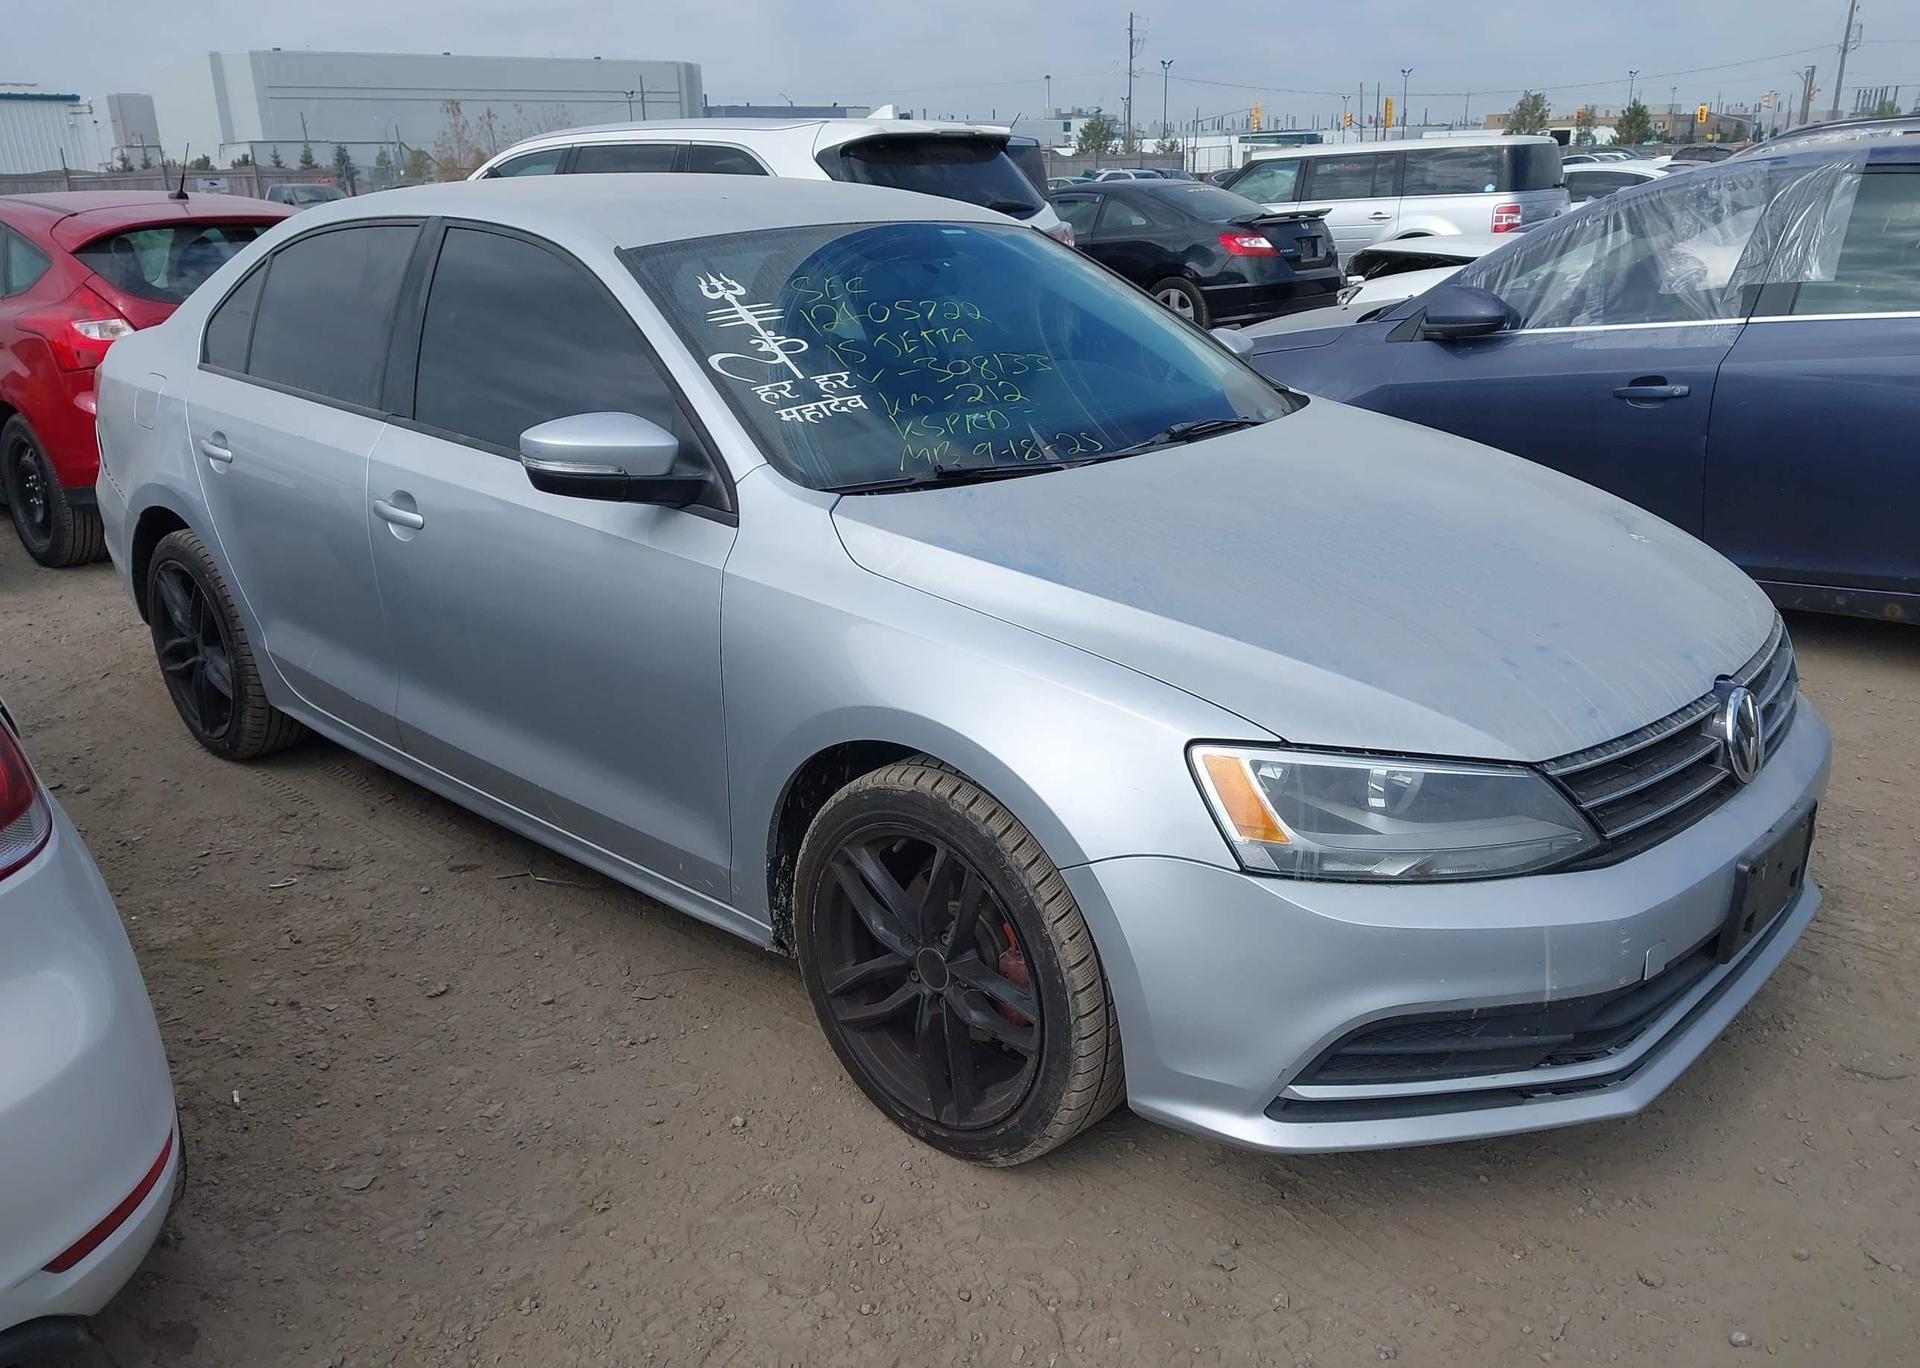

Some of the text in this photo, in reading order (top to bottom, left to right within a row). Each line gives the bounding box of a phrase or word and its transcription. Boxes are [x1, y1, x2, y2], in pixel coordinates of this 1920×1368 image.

[790, 275, 870, 303] SEC
[873, 327, 974, 358] JETTA
[751, 371, 857, 405] हर हर
[774, 394, 869, 424] महादेव
